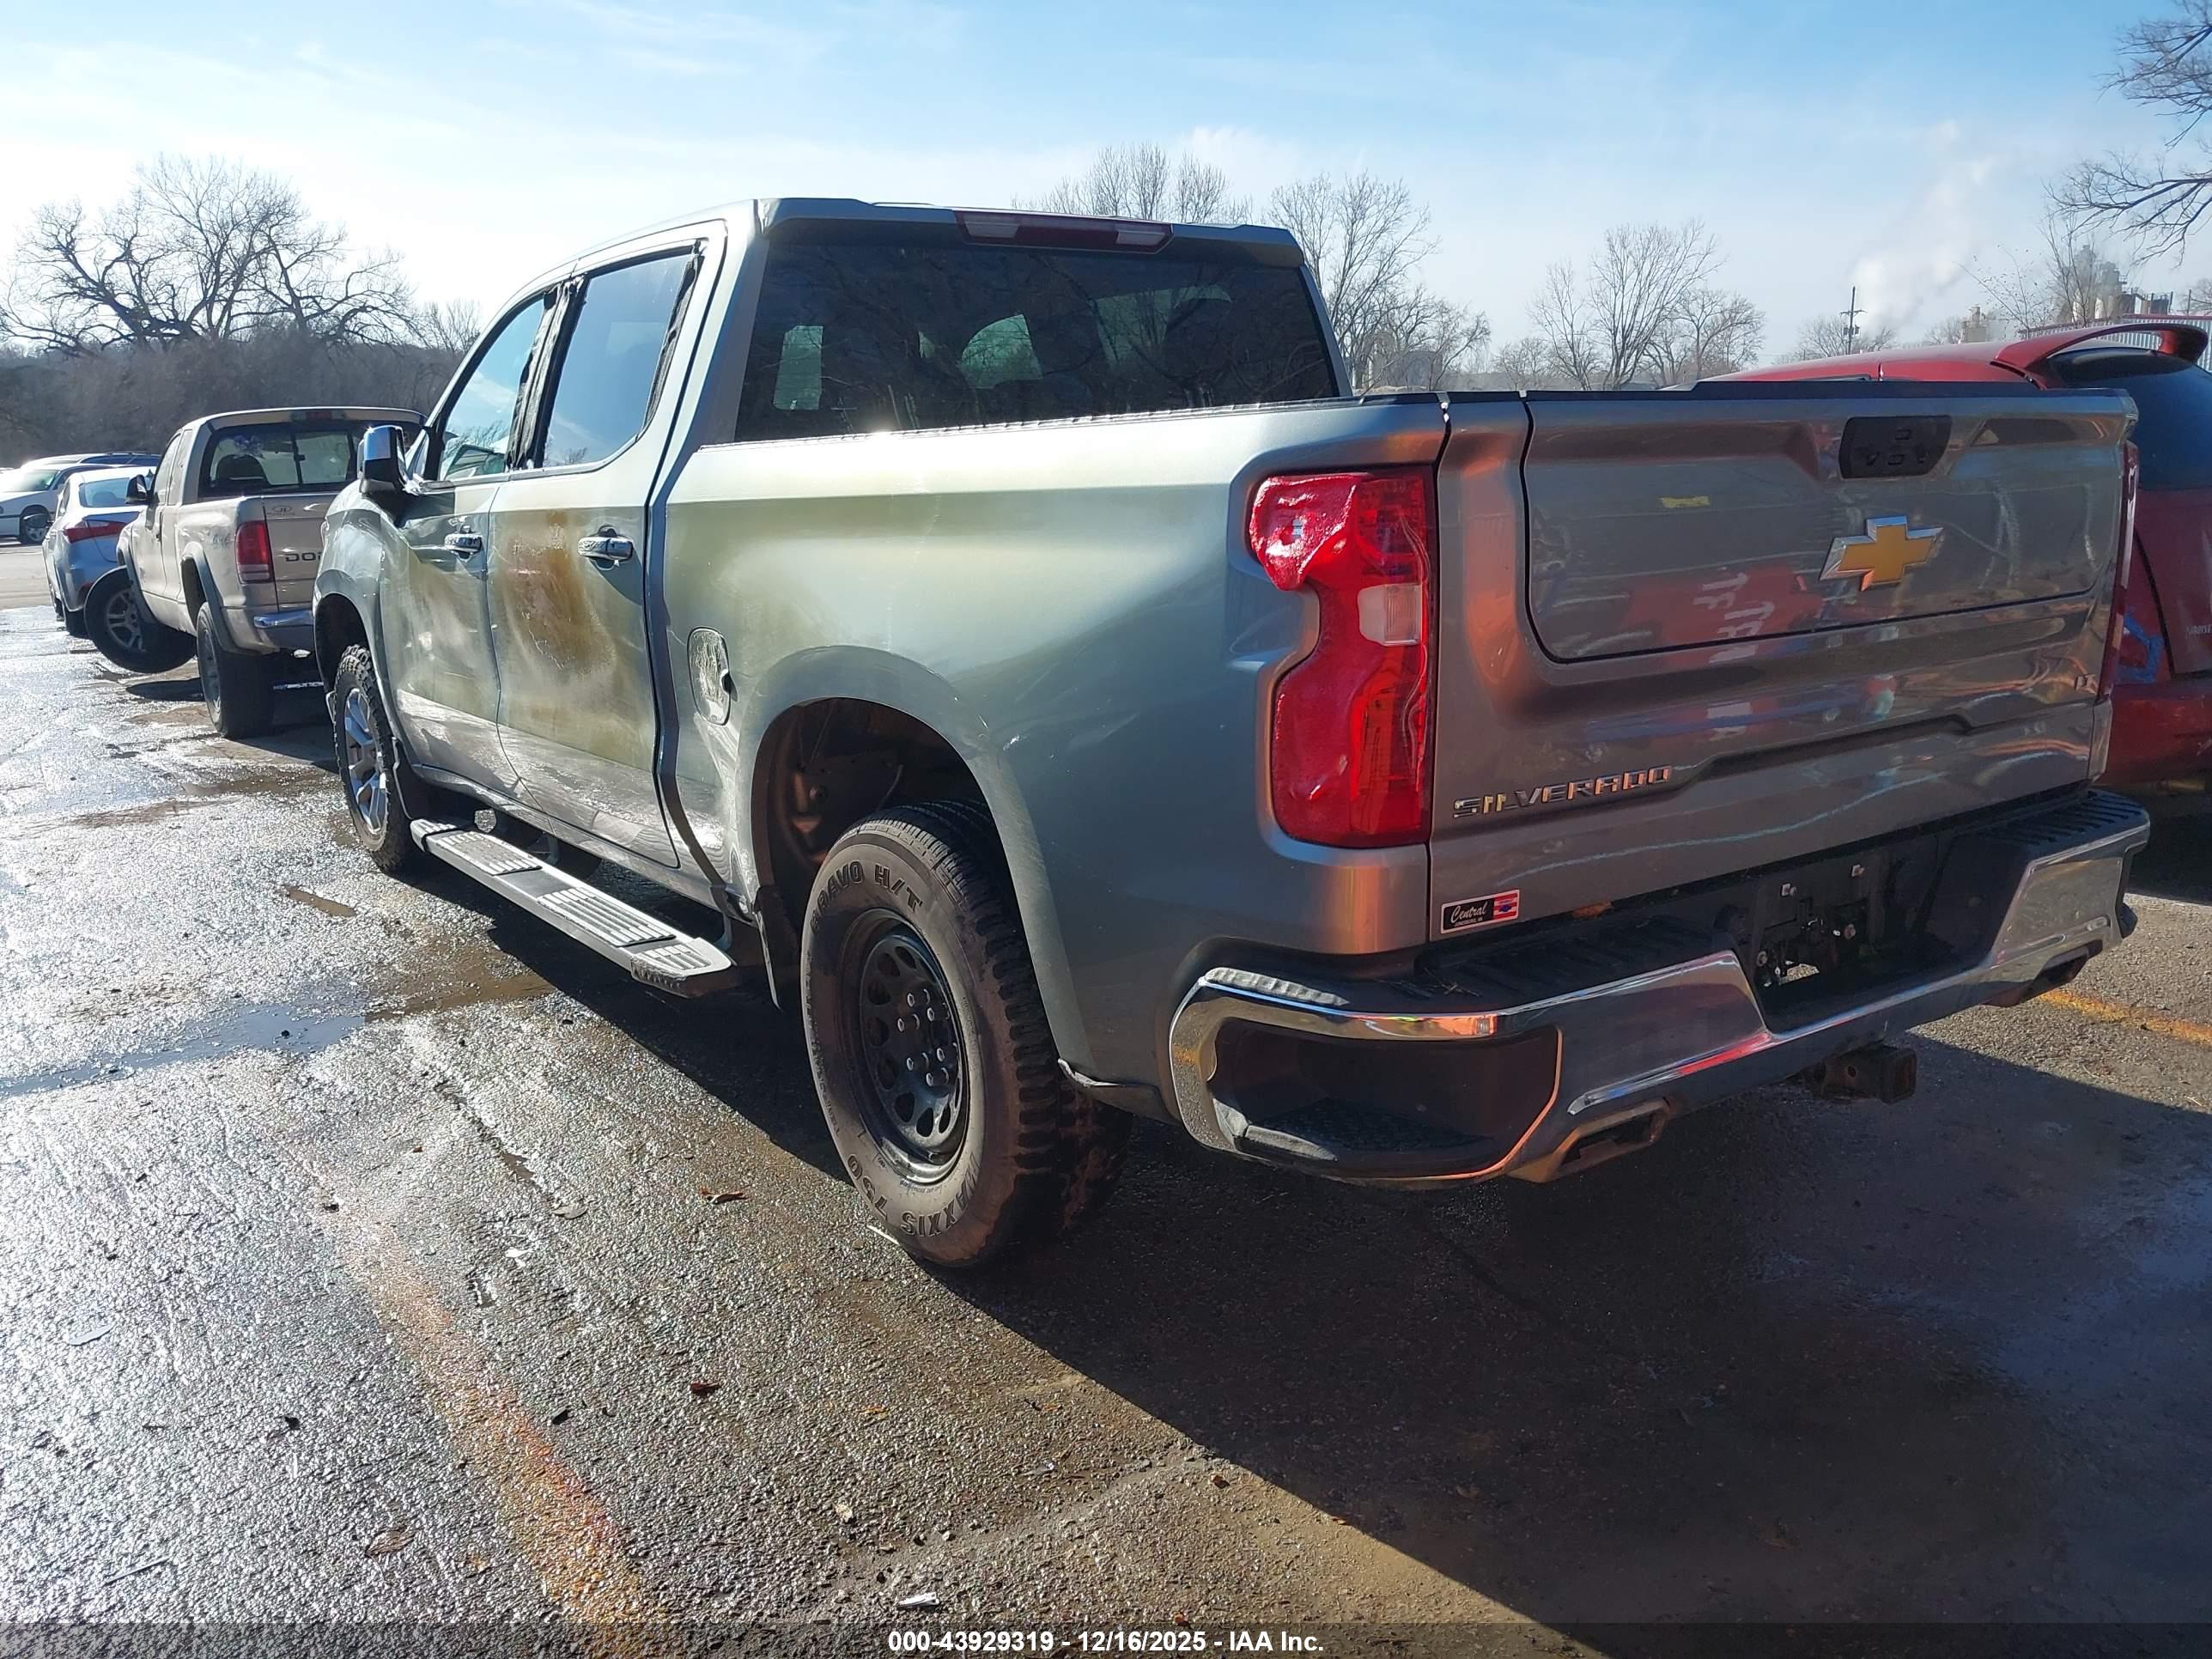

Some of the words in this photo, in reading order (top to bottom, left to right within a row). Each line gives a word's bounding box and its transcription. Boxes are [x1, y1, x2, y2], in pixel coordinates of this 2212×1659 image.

[1453, 765, 1672, 818] SILVERADO
[874, 862, 923, 913] H/T
[1450, 901, 1488, 923] Central
[901, 1152, 981, 1237] MAXXIS
